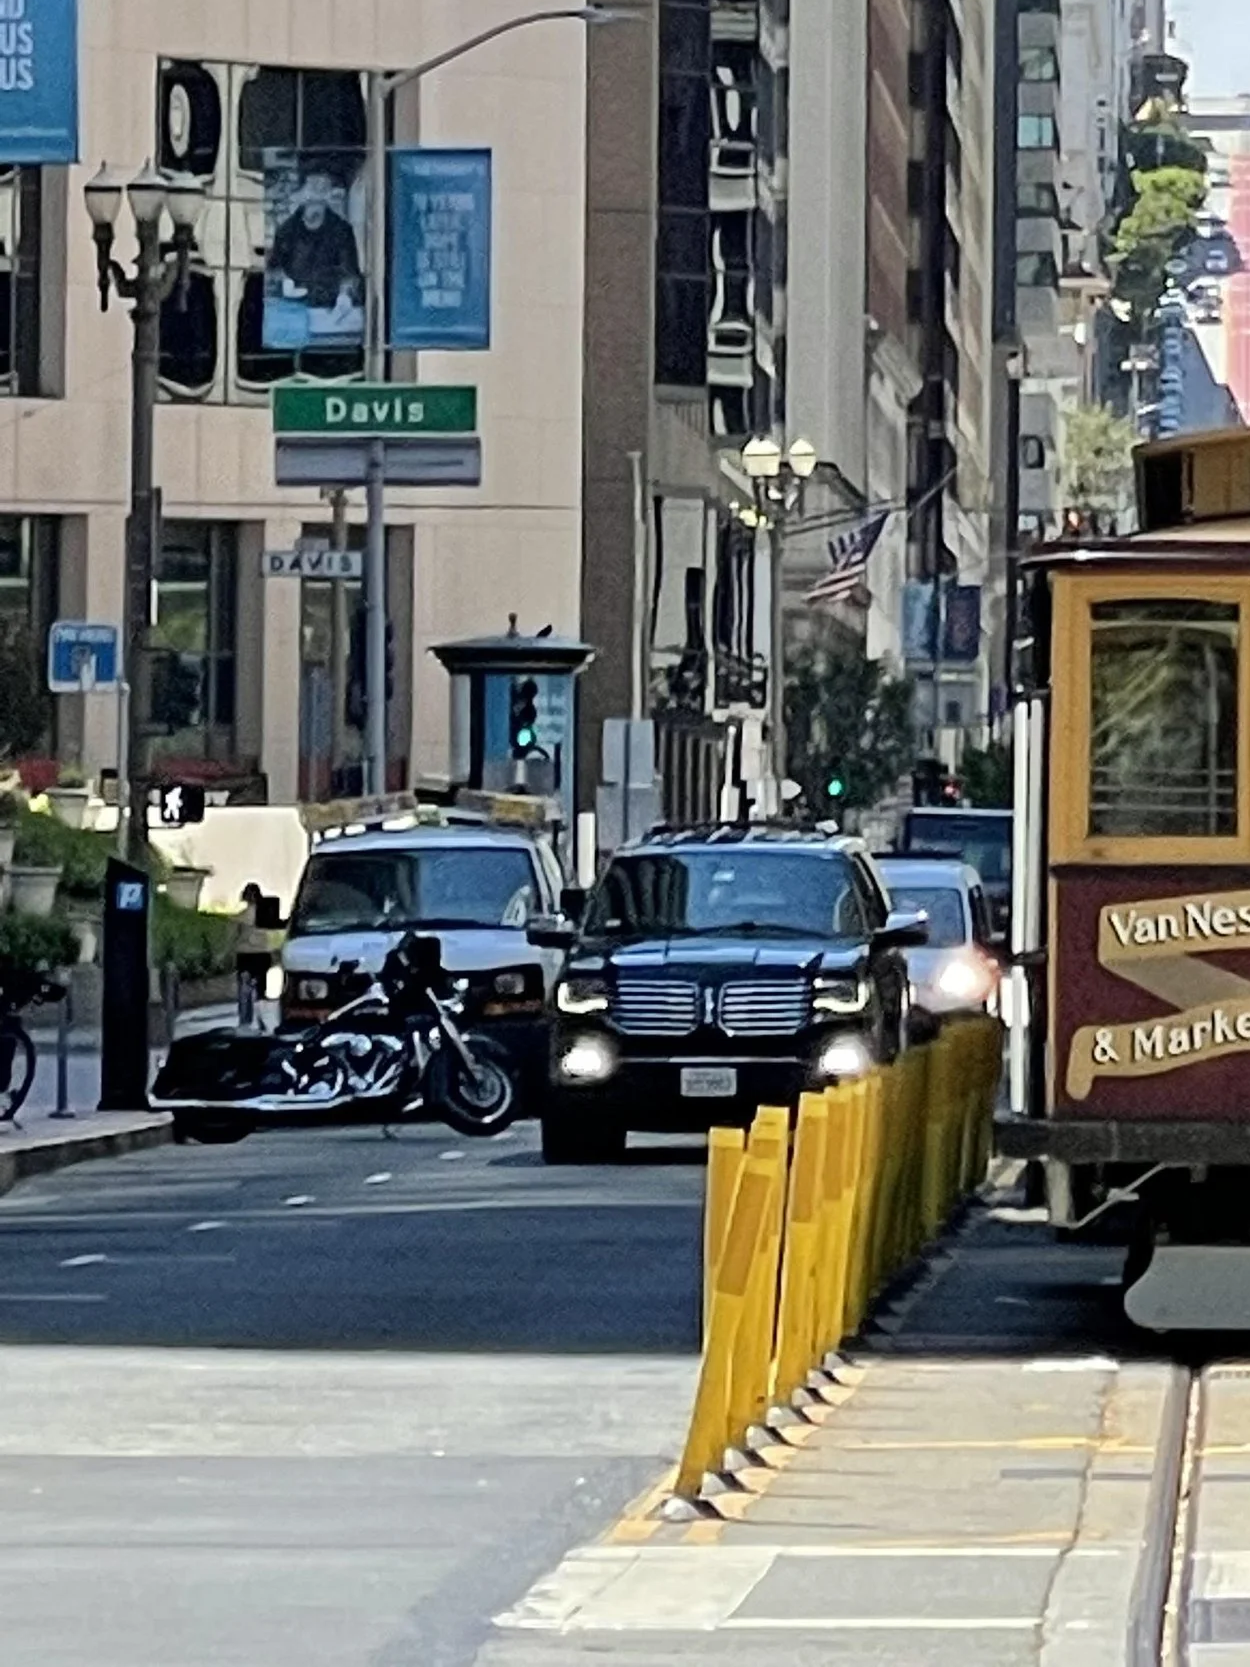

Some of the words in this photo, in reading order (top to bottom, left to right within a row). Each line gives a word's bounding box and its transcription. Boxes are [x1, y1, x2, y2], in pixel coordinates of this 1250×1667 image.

[324, 396, 425, 424] Davis
[269, 552, 353, 572] DAVIS
[1093, 1027, 1120, 1064] &
